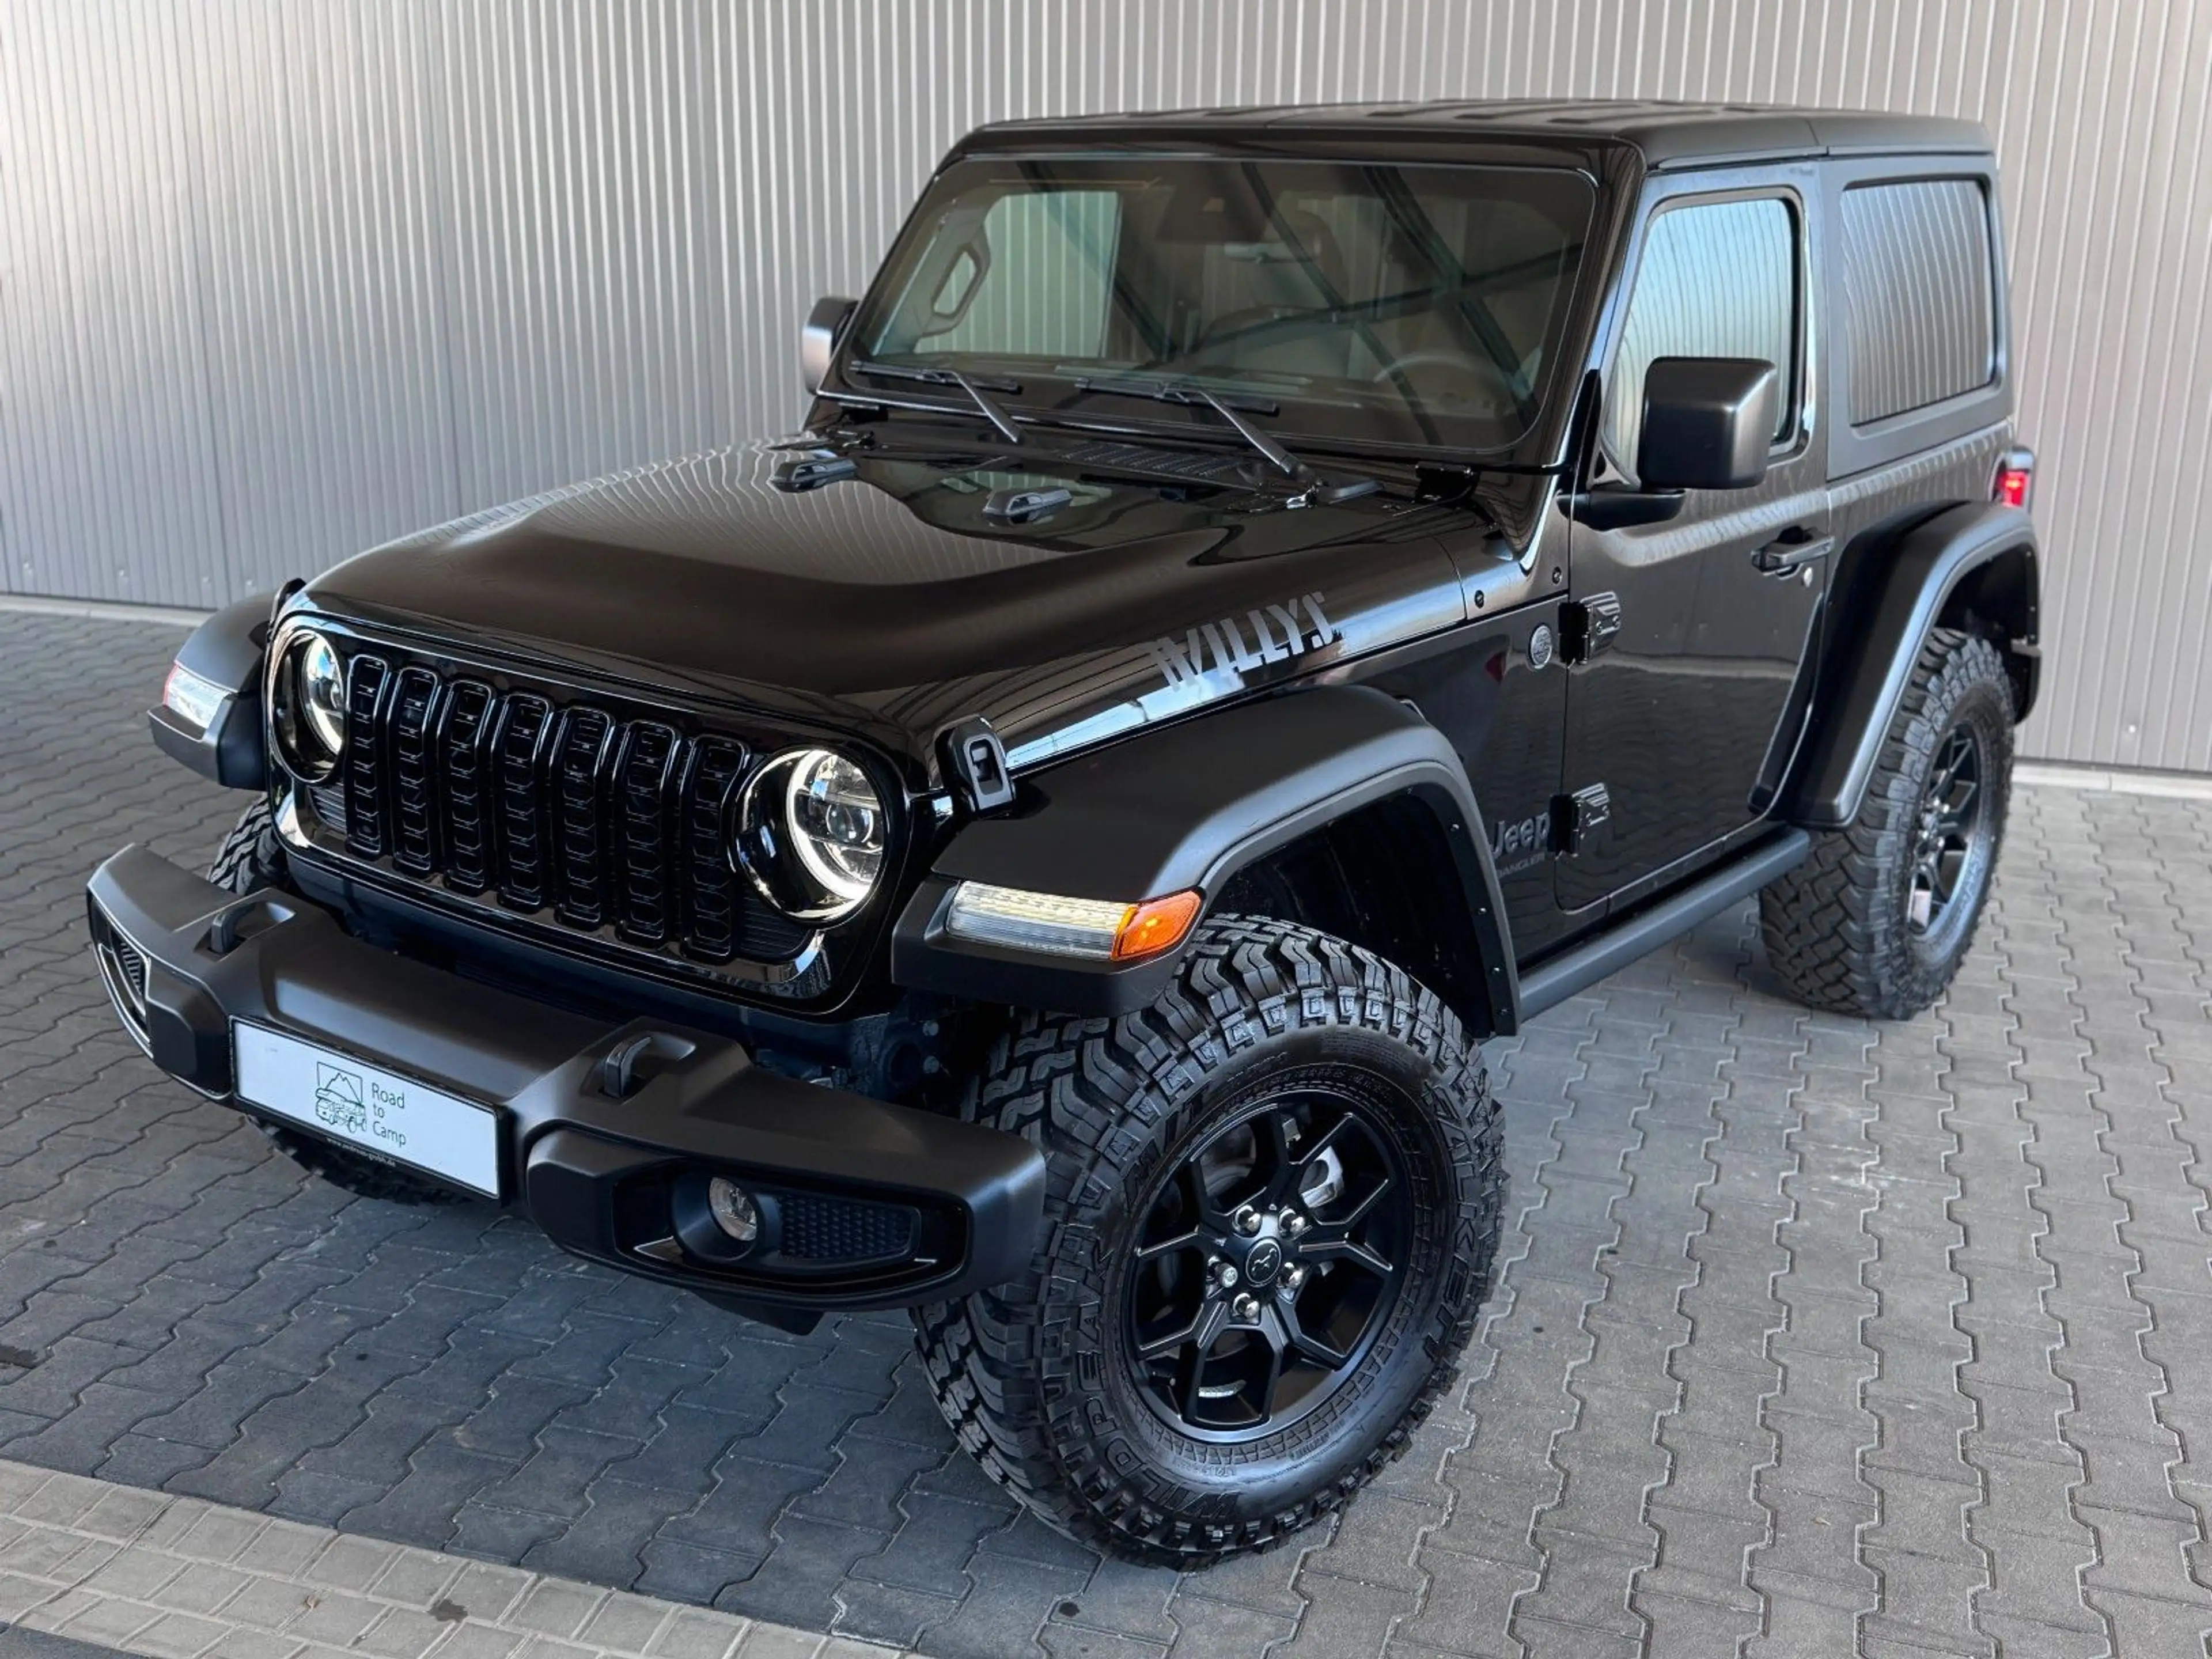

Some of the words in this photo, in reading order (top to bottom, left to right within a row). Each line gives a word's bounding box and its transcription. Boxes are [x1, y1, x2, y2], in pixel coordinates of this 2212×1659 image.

[1143, 590, 1336, 692] WILLYS
[1490, 811, 1551, 860] Jeep
[372, 1082, 405, 1110] Road
[373, 1103, 385, 1119] to
[373, 1120, 406, 1148] Camp
[1419, 1081, 1477, 1363] FALKEN
[1075, 1243, 1242, 1522] WILDPEAK
